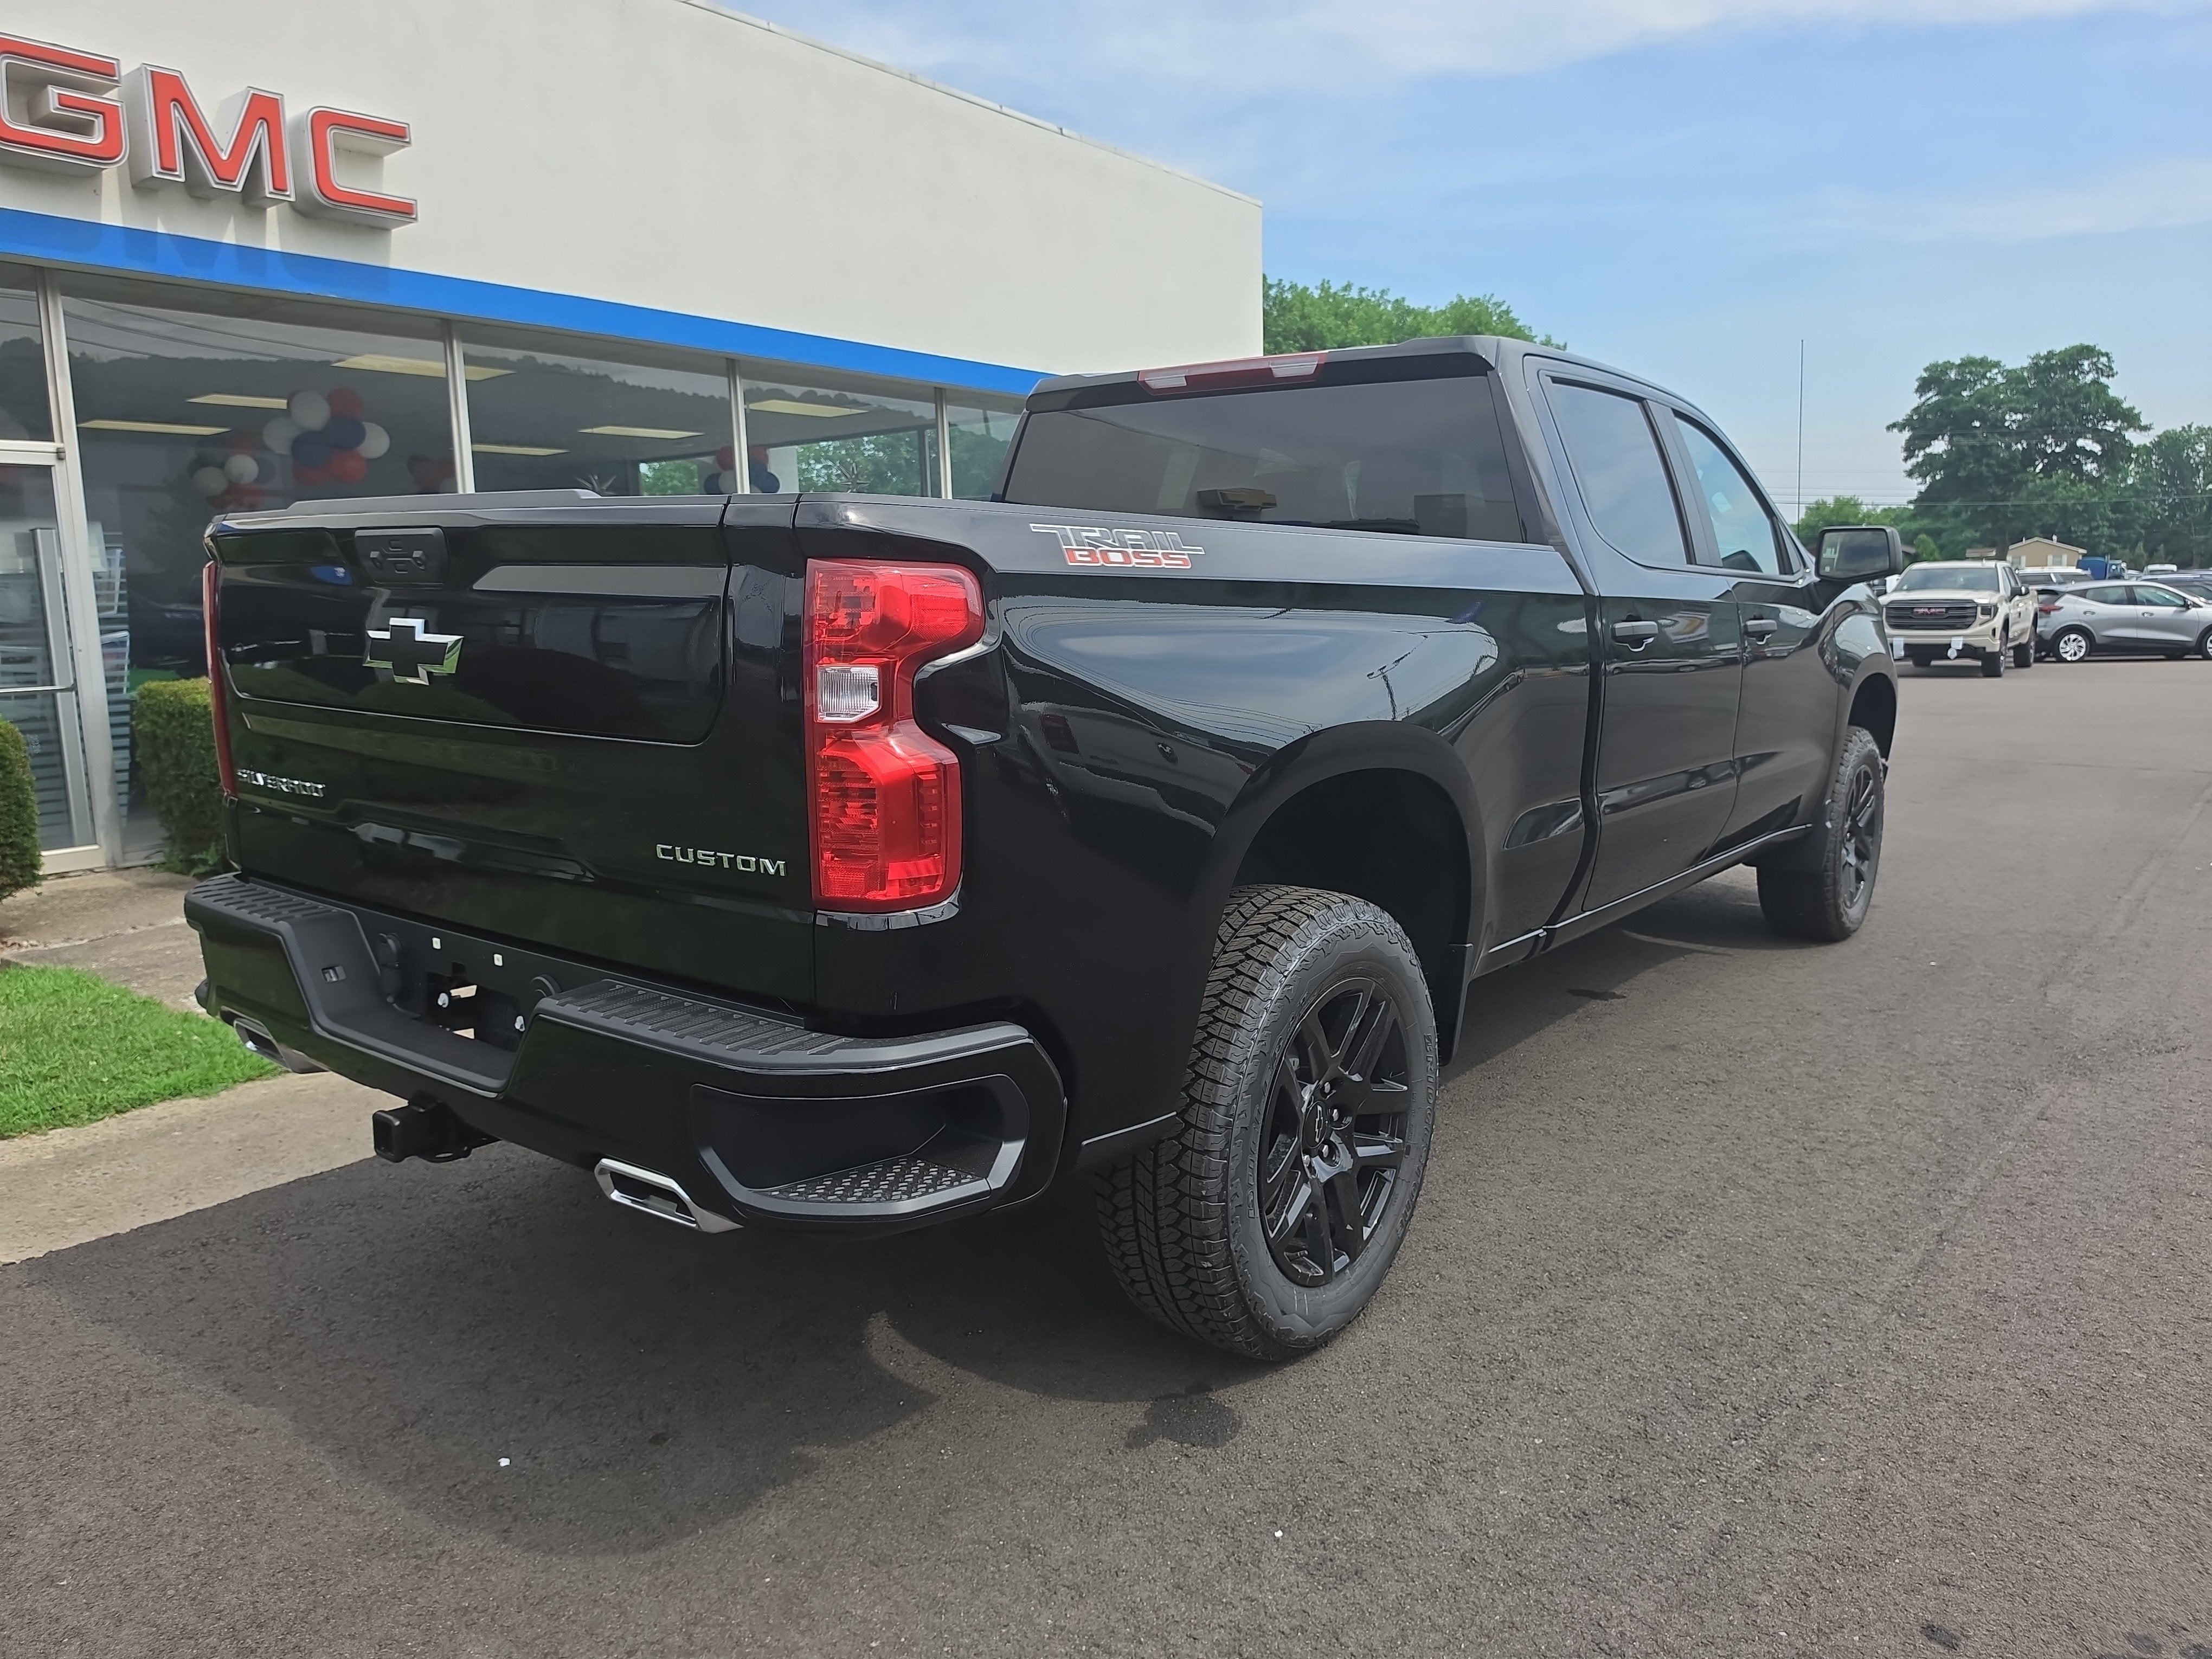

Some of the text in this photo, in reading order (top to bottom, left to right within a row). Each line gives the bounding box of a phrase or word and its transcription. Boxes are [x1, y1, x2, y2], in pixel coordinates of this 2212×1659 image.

[0, 33, 419, 224] GMC
[1029, 523, 1205, 555] TRAIL
[1064, 547, 1192, 569] BOSS
[236, 769, 326, 798] SILVERADO
[657, 844, 786, 876] CUSTOM
[1397, 1034, 1435, 1238] BRIDGESTONE
